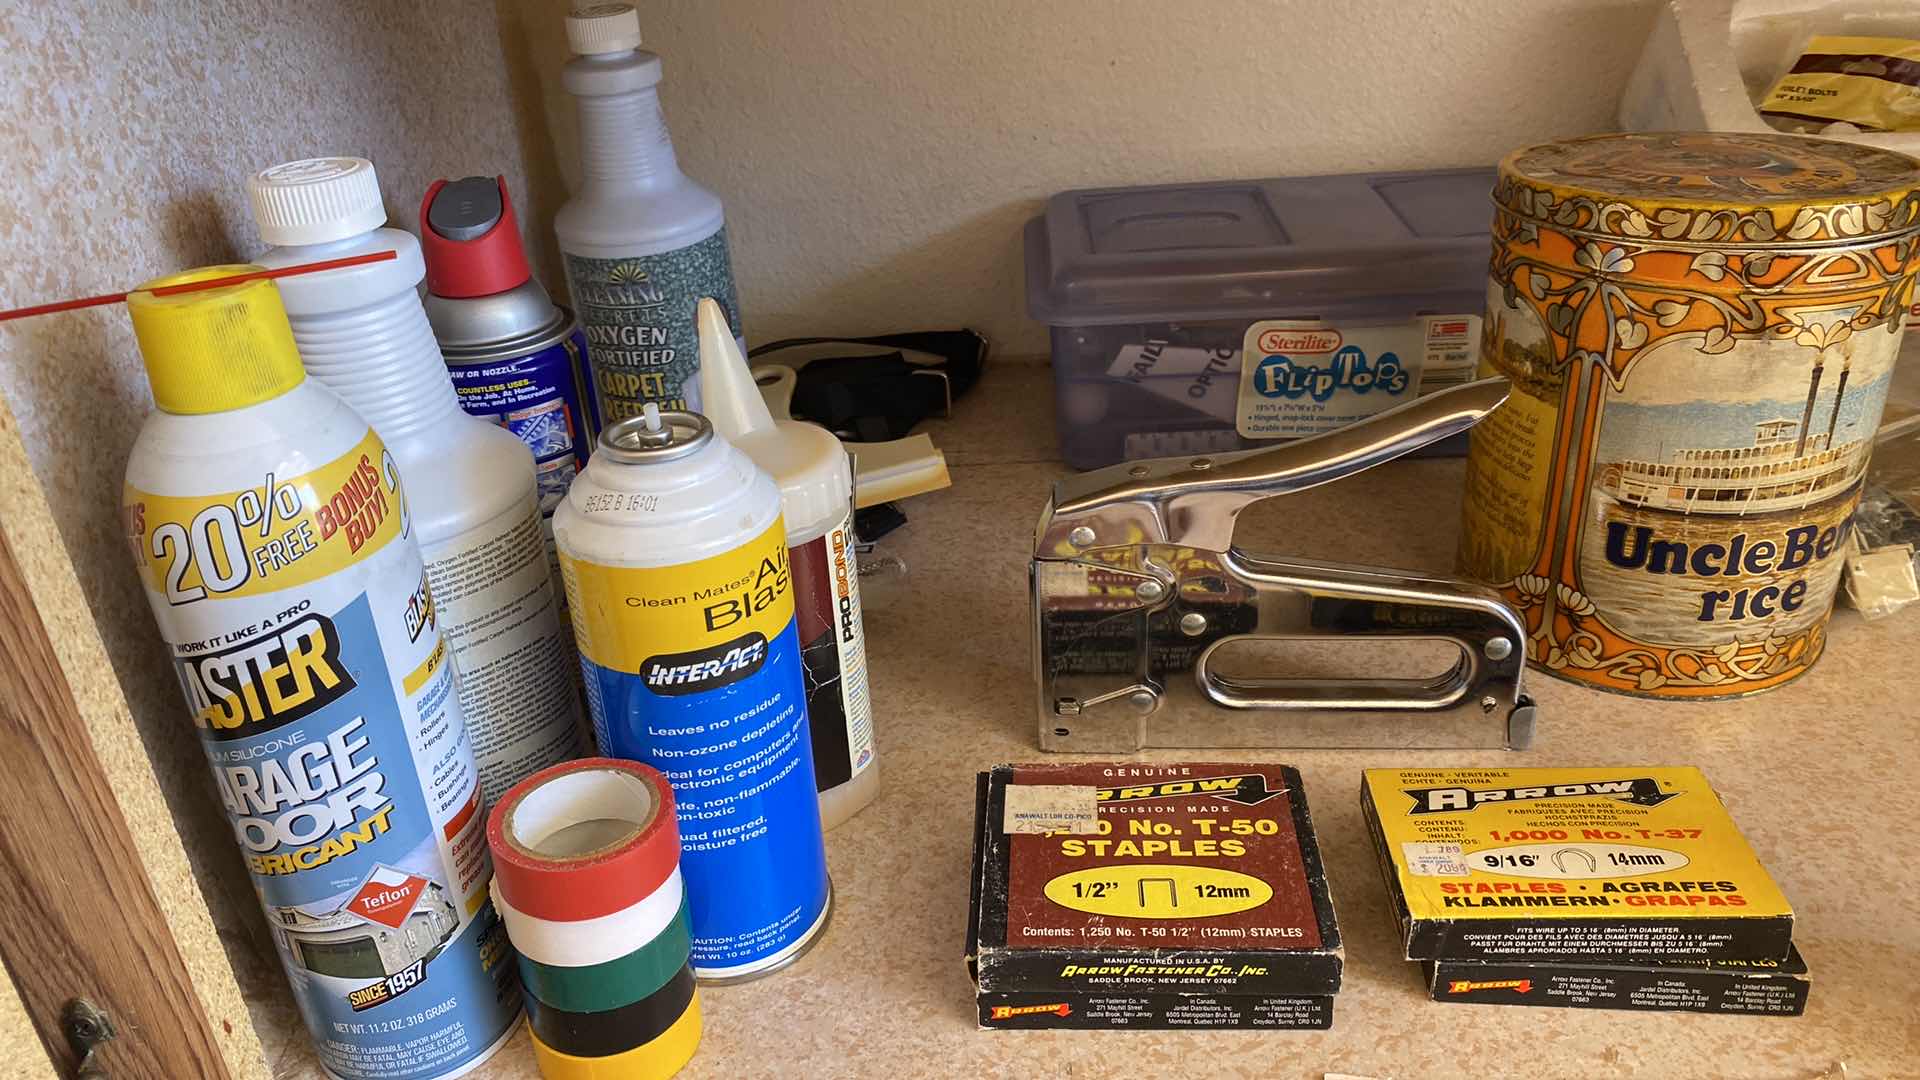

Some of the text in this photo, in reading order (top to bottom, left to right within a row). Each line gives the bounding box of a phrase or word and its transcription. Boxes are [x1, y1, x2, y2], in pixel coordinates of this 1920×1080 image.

[587, 326, 668, 346] OXYGEN
[1267, 334, 1331, 351] Sterilite
[457, 383, 506, 394] COUNTLESS
[469, 393, 482, 401] the
[492, 386, 556, 406] and Recreation
[152, 472, 302, 606] 20%
[252, 519, 318, 577] FREE
[314, 454, 380, 541] BONUS
[348, 489, 390, 554] BUY!
[1606, 521, 1775, 577] Uncle
[625, 594, 686, 608] Clean
[704, 567, 790, 633] Blas
[1697, 577, 1809, 621] rice
[177, 599, 311, 652] WORK IT LIKE A PRO
[175, 618, 341, 729] ASTER
[420, 712, 446, 737] Rollers
[648, 692, 781, 737] Leaves no residue
[423, 723, 450, 750] Hinges
[652, 703, 795, 758] Non-ozone depleting
[232, 730, 306, 761] SILICONE
[697, 731, 791, 777] for computers
[214, 715, 378, 815] ARAGE
[433, 745, 457, 775] ALSO
[434, 760, 459, 787] Cables
[671, 774, 736, 791] ectronic
[1103, 768, 1192, 777] GENUINE
[1096, 777, 1243, 801] RROW
[1428, 781, 1633, 811] ARROW
[233, 771, 392, 853] OOR
[676, 806, 737, 821] on-toxic
[683, 826, 769, 852] oisture free
[1129, 819, 1182, 836] No.
[1192, 819, 1279, 836] T-50
[1489, 828, 1704, 843] 1,000 No. T-37
[249, 804, 395, 876] BRICANT
[1061, 839, 1246, 857] STAPLES
[1608, 852, 1666, 866] 14mm
[361, 885, 411, 909] Teflon
[1194, 883, 1251, 899] 12mm
[1440, 881, 1738, 894] STAPLES AGRAFES
[1444, 895, 1748, 908] KLAMMERN GRAPAS
[734, 939, 755, 949] read
[757, 930, 778, 943] back
[739, 922, 780, 941] Contents
[1022, 926, 1075, 938] Contents:
[1079, 926, 1112, 939] 1,250
[1116, 926, 1137, 938] No.
[1140, 926, 1167, 938] T-50
[1200, 926, 1247, 939] (12mm)
[1250, 927, 1303, 938] STAPLES
[1061, 965, 1124, 977] ARROW
[1123, 964, 1204, 977] FASTENER
[350, 962, 424, 1006] SINCE 1957
[333, 998, 457, 1034] NET WT. 11.2 318 GRAMS
